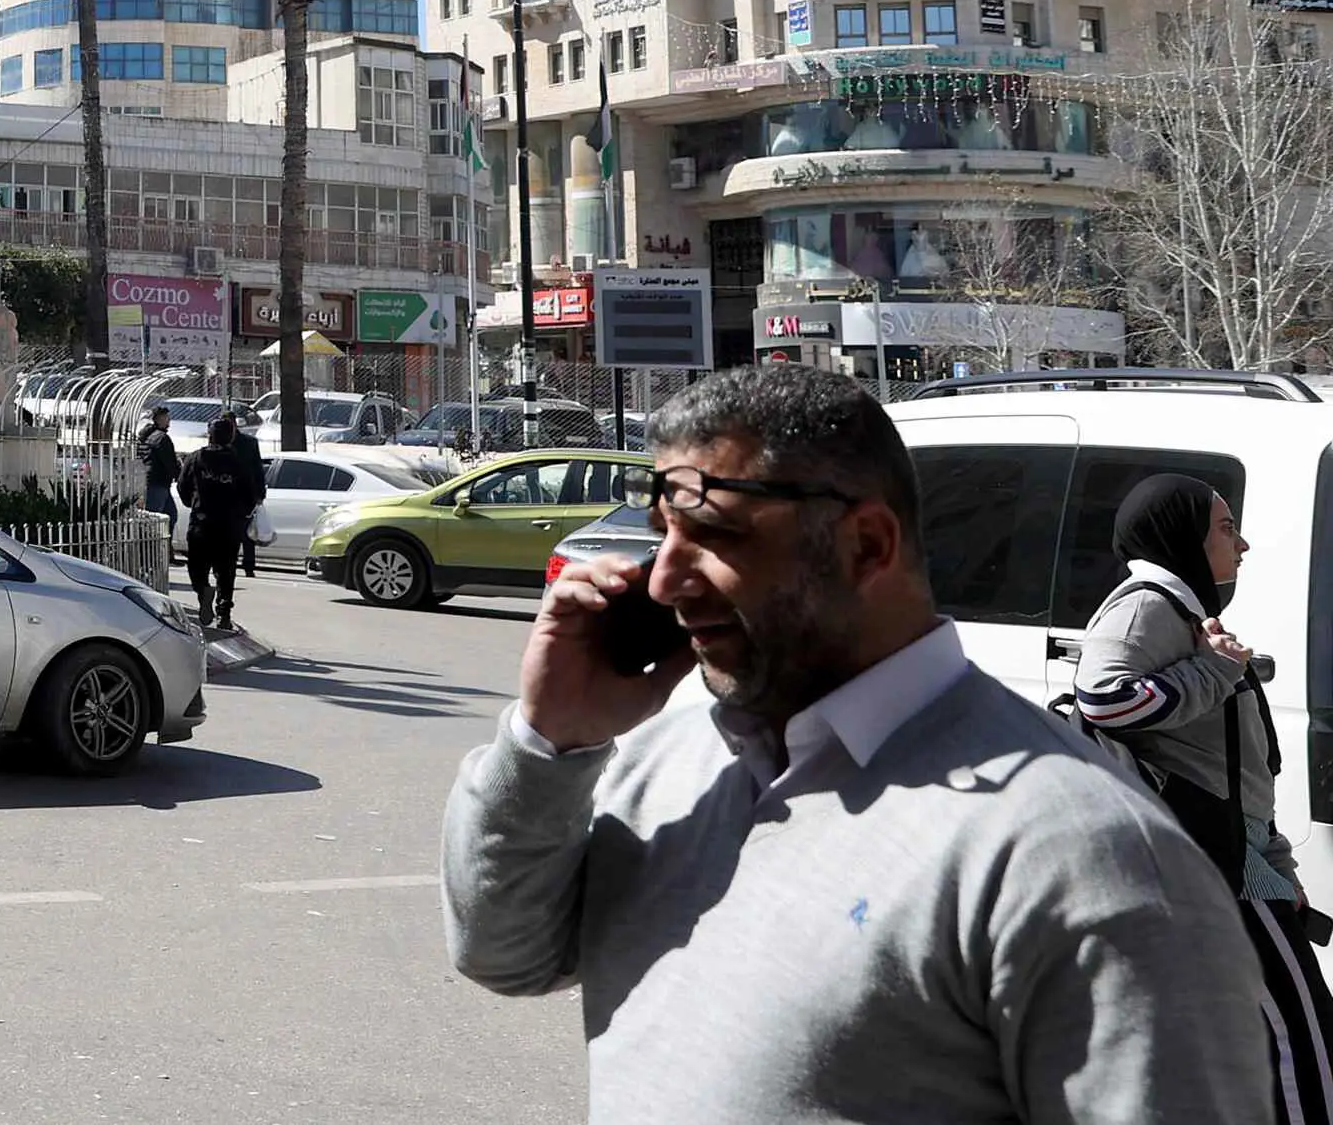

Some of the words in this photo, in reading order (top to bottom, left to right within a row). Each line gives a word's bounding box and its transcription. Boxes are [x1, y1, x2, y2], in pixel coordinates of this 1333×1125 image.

[111, 278, 191, 306] Cozmo
[161, 305, 224, 330] Cente
[765, 315, 800, 337] K&M
